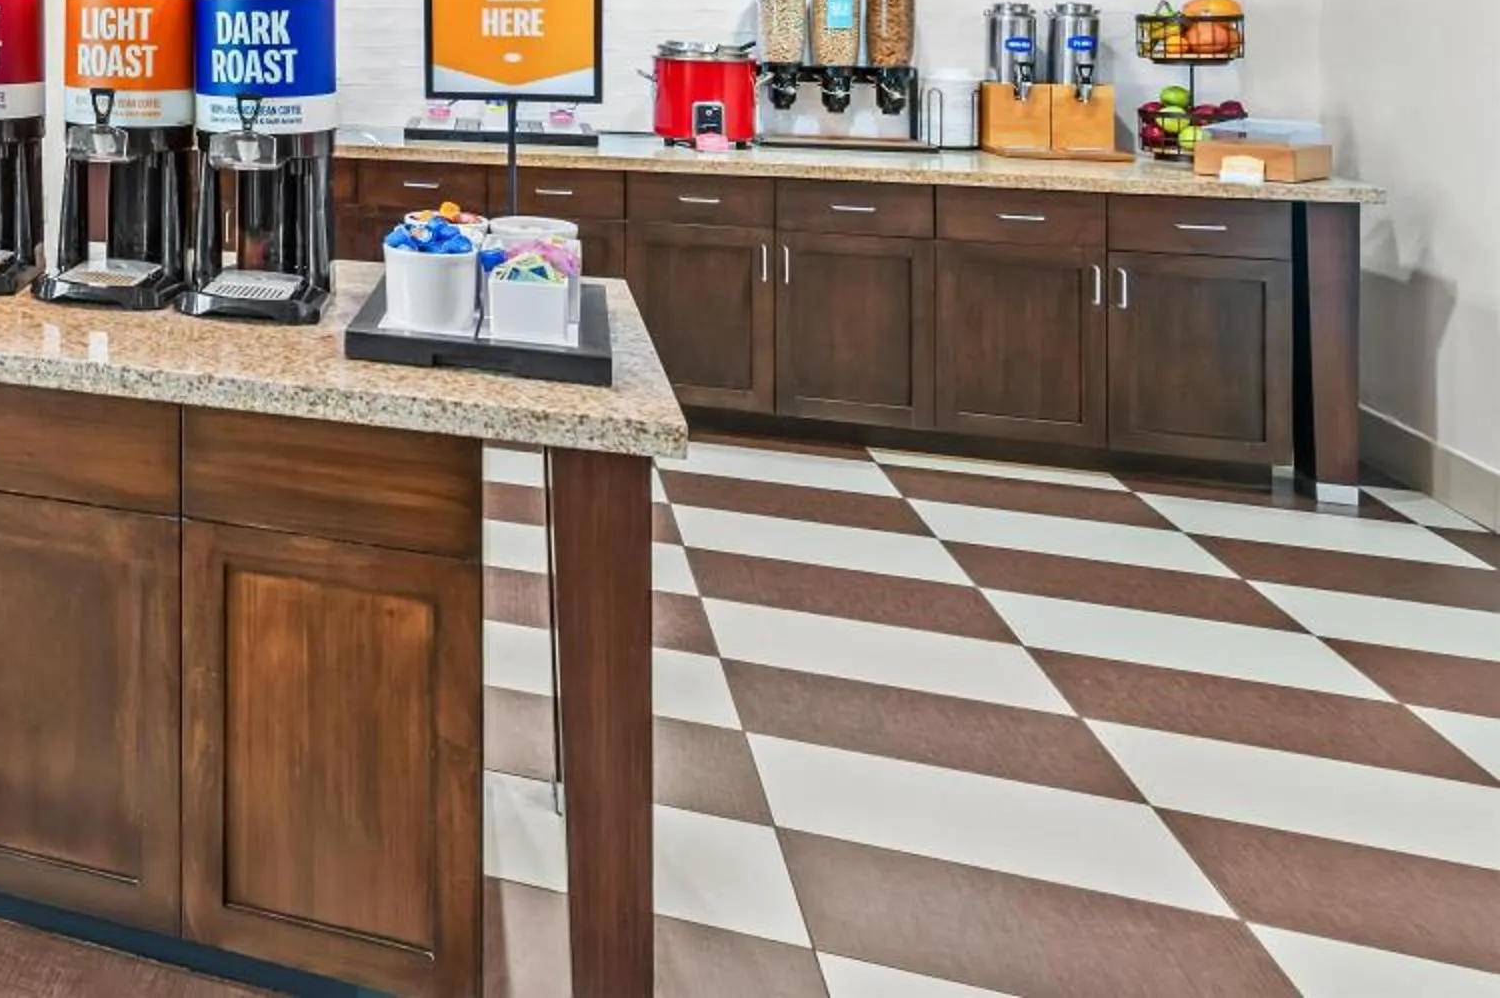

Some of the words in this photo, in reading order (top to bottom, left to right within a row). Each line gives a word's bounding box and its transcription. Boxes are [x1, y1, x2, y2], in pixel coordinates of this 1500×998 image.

[80, 7, 154, 41] LIGHT
[215, 10, 291, 45] DARK
[481, 7, 545, 38] HERE
[77, 44, 158, 78] ROAST
[211, 48, 298, 84] ROAST
